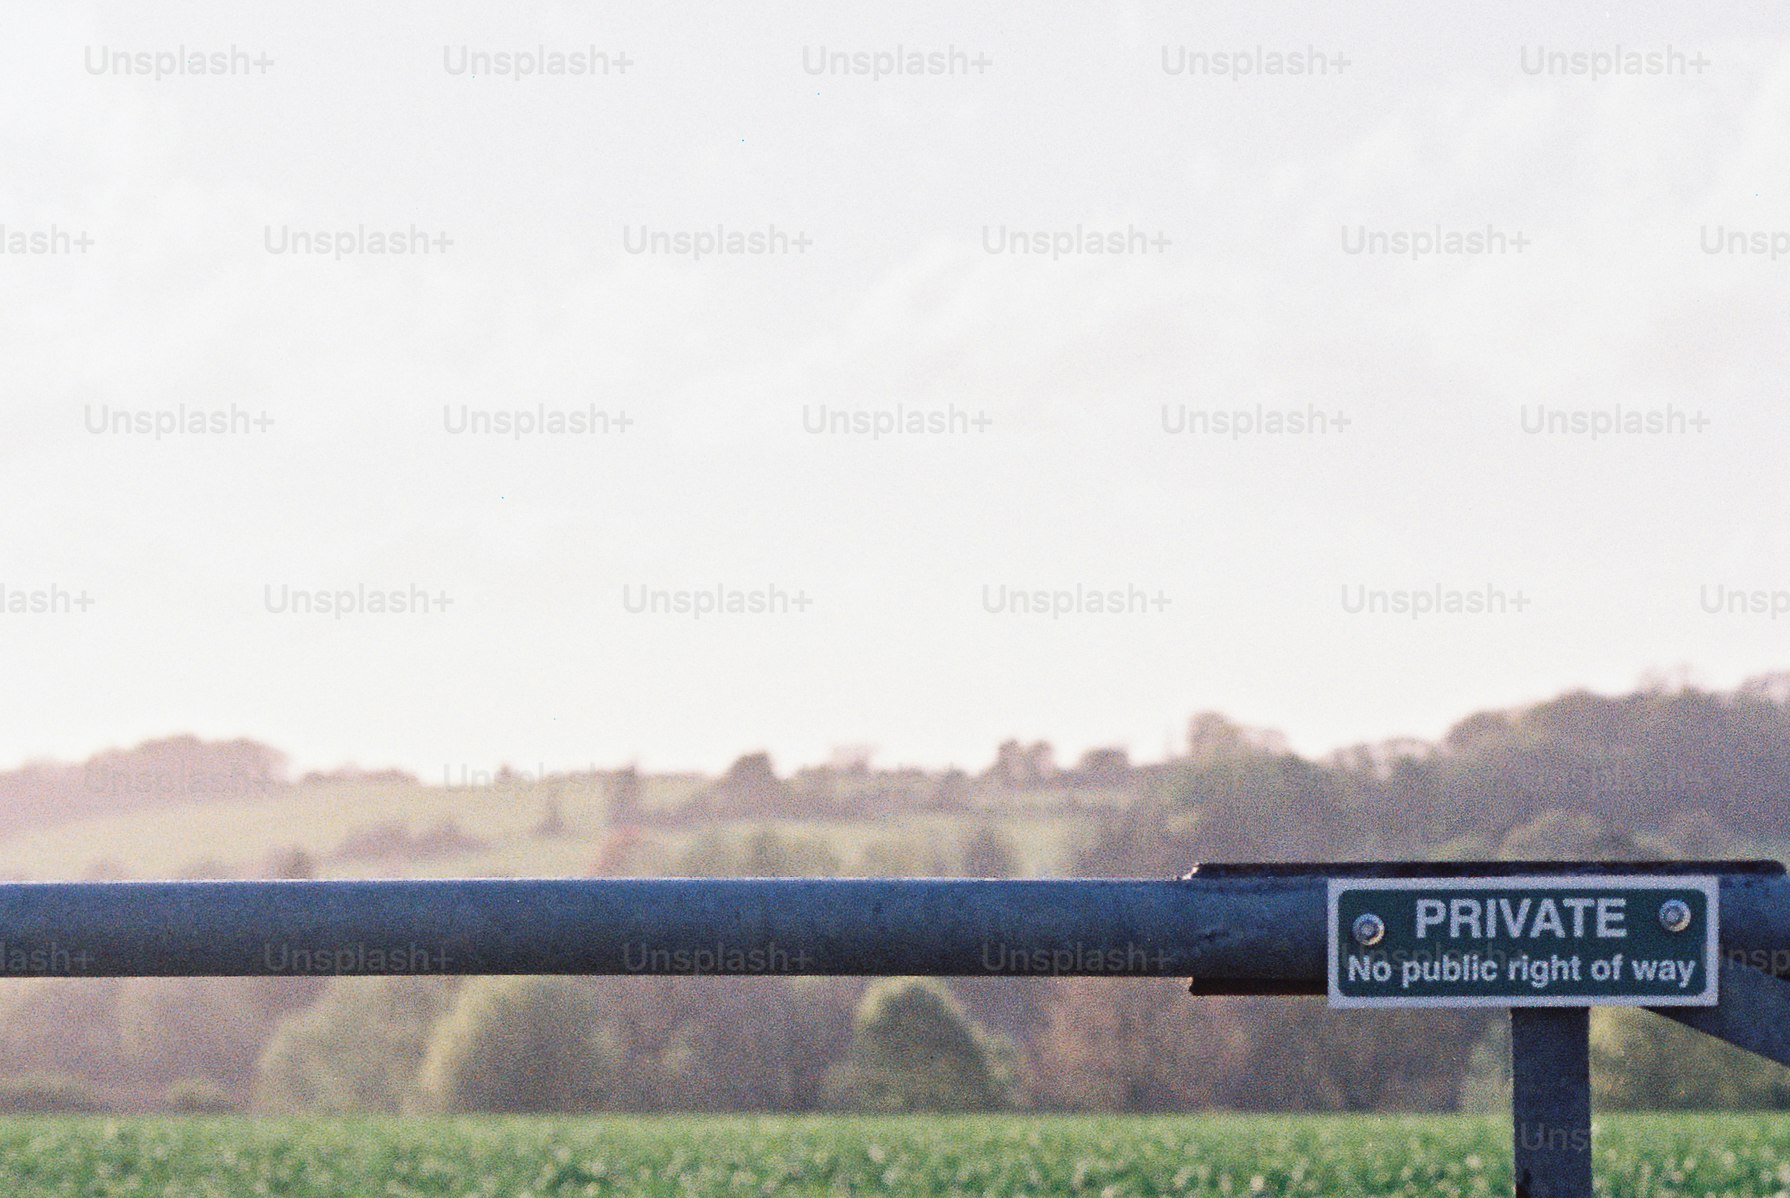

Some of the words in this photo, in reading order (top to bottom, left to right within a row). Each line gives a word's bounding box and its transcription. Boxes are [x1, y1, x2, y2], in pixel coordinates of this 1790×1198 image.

[1416, 898, 1628, 938] PRIVATE
[1348, 955, 1392, 982] No
[1402, 954, 1498, 988] public
[1508, 954, 1582, 988] right
[1590, 953, 1623, 981] of
[1631, 959, 1696, 988] way
